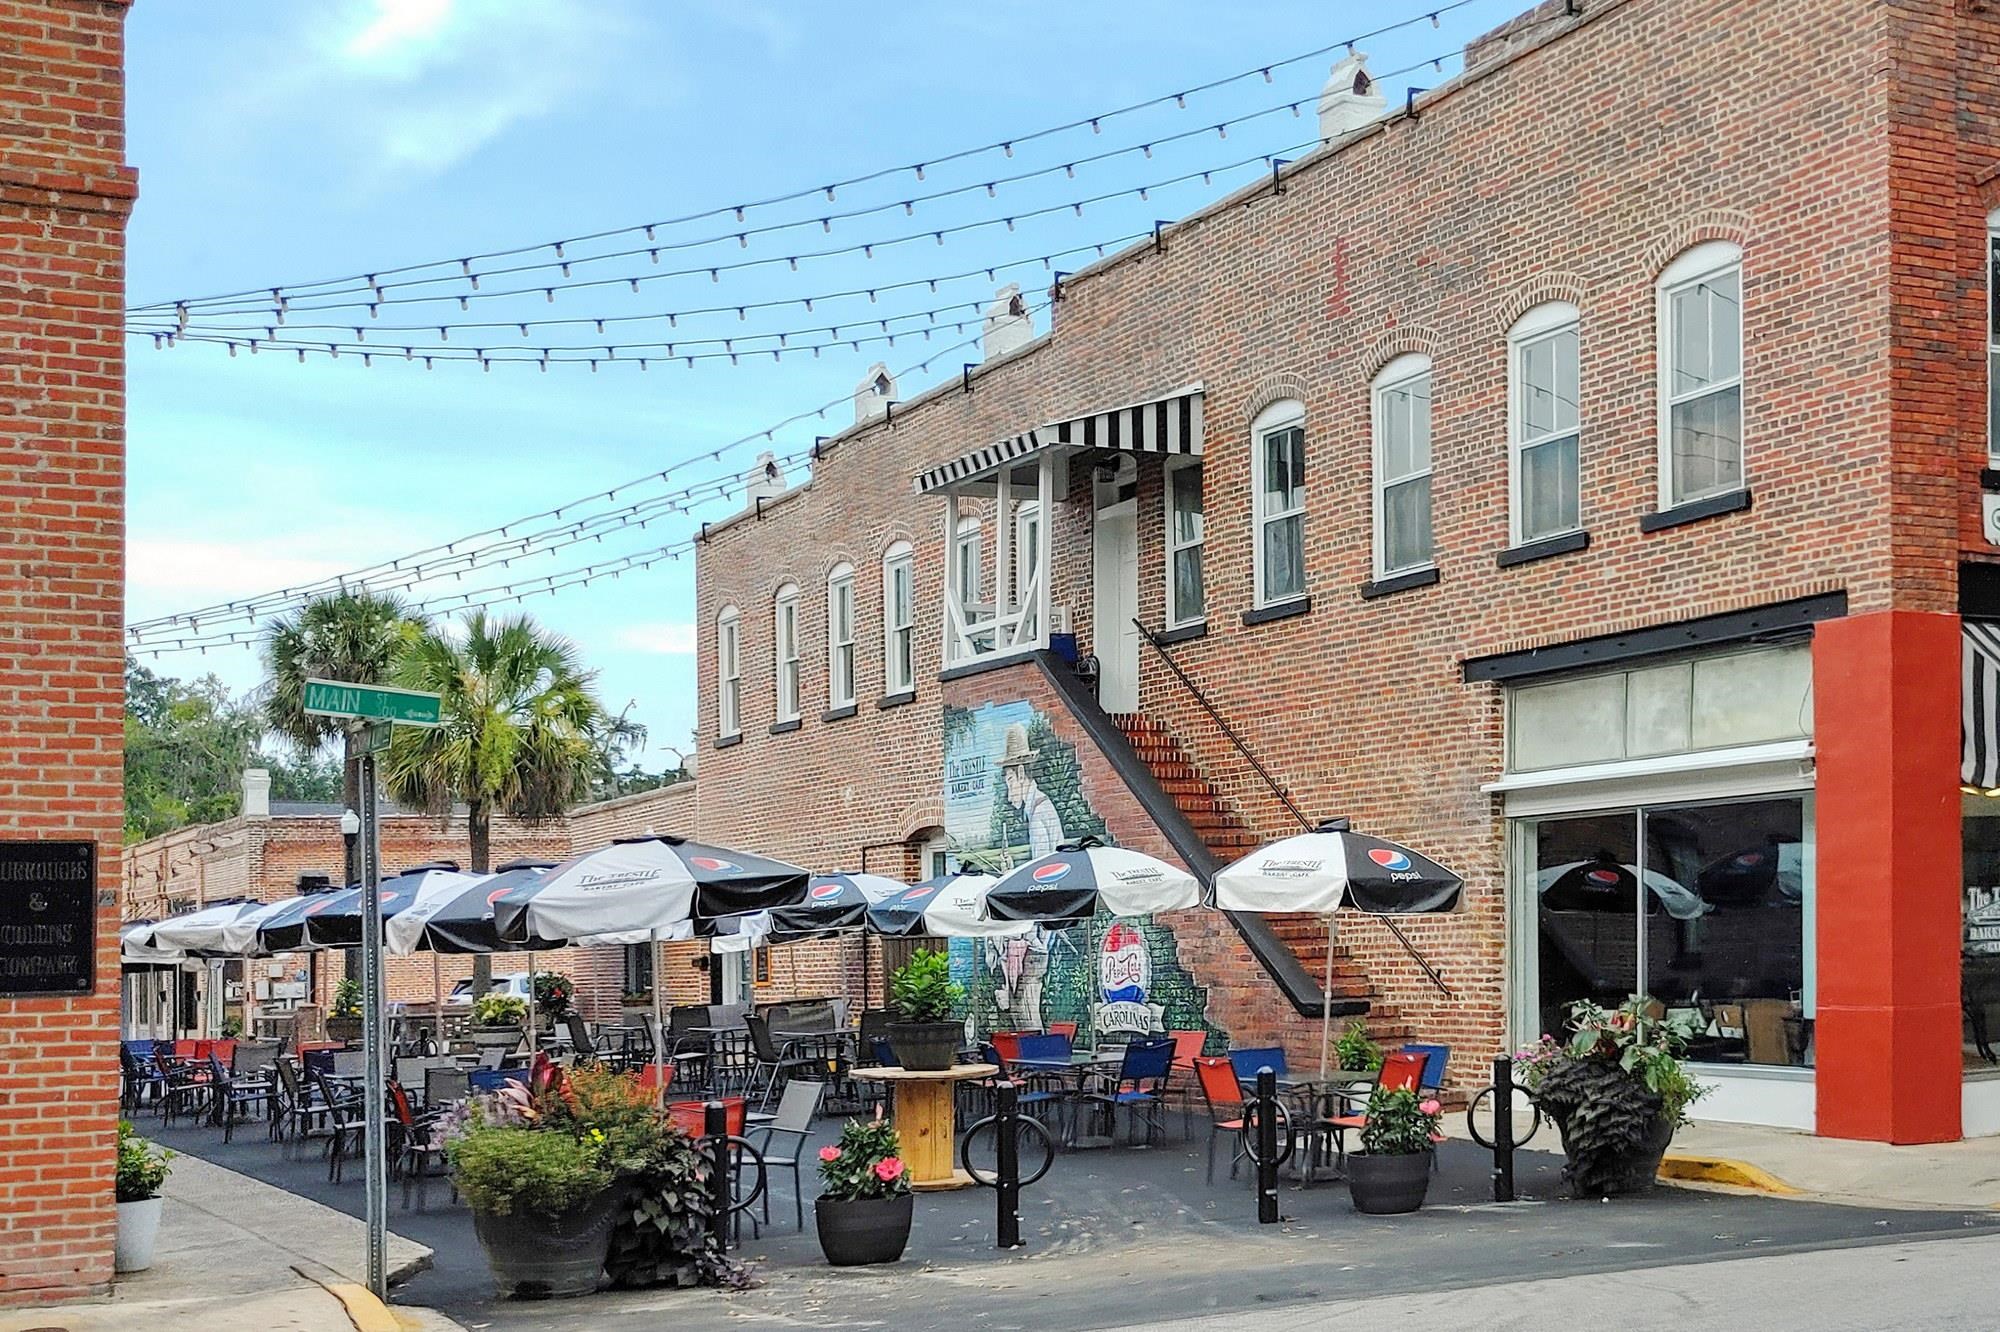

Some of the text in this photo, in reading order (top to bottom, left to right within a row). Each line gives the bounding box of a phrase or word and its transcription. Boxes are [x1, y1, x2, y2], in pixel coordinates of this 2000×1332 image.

[309, 686, 389, 712] MAIN ST
[0, 860, 88, 881] URROUGHS
[1390, 871, 1423, 883] pepsi
[1027, 883, 1059, 893] pepsi
[29, 892, 48, 911] &
[1967, 887, 1991, 911] The
[1103, 1010, 1149, 1030] CAROLINAS
